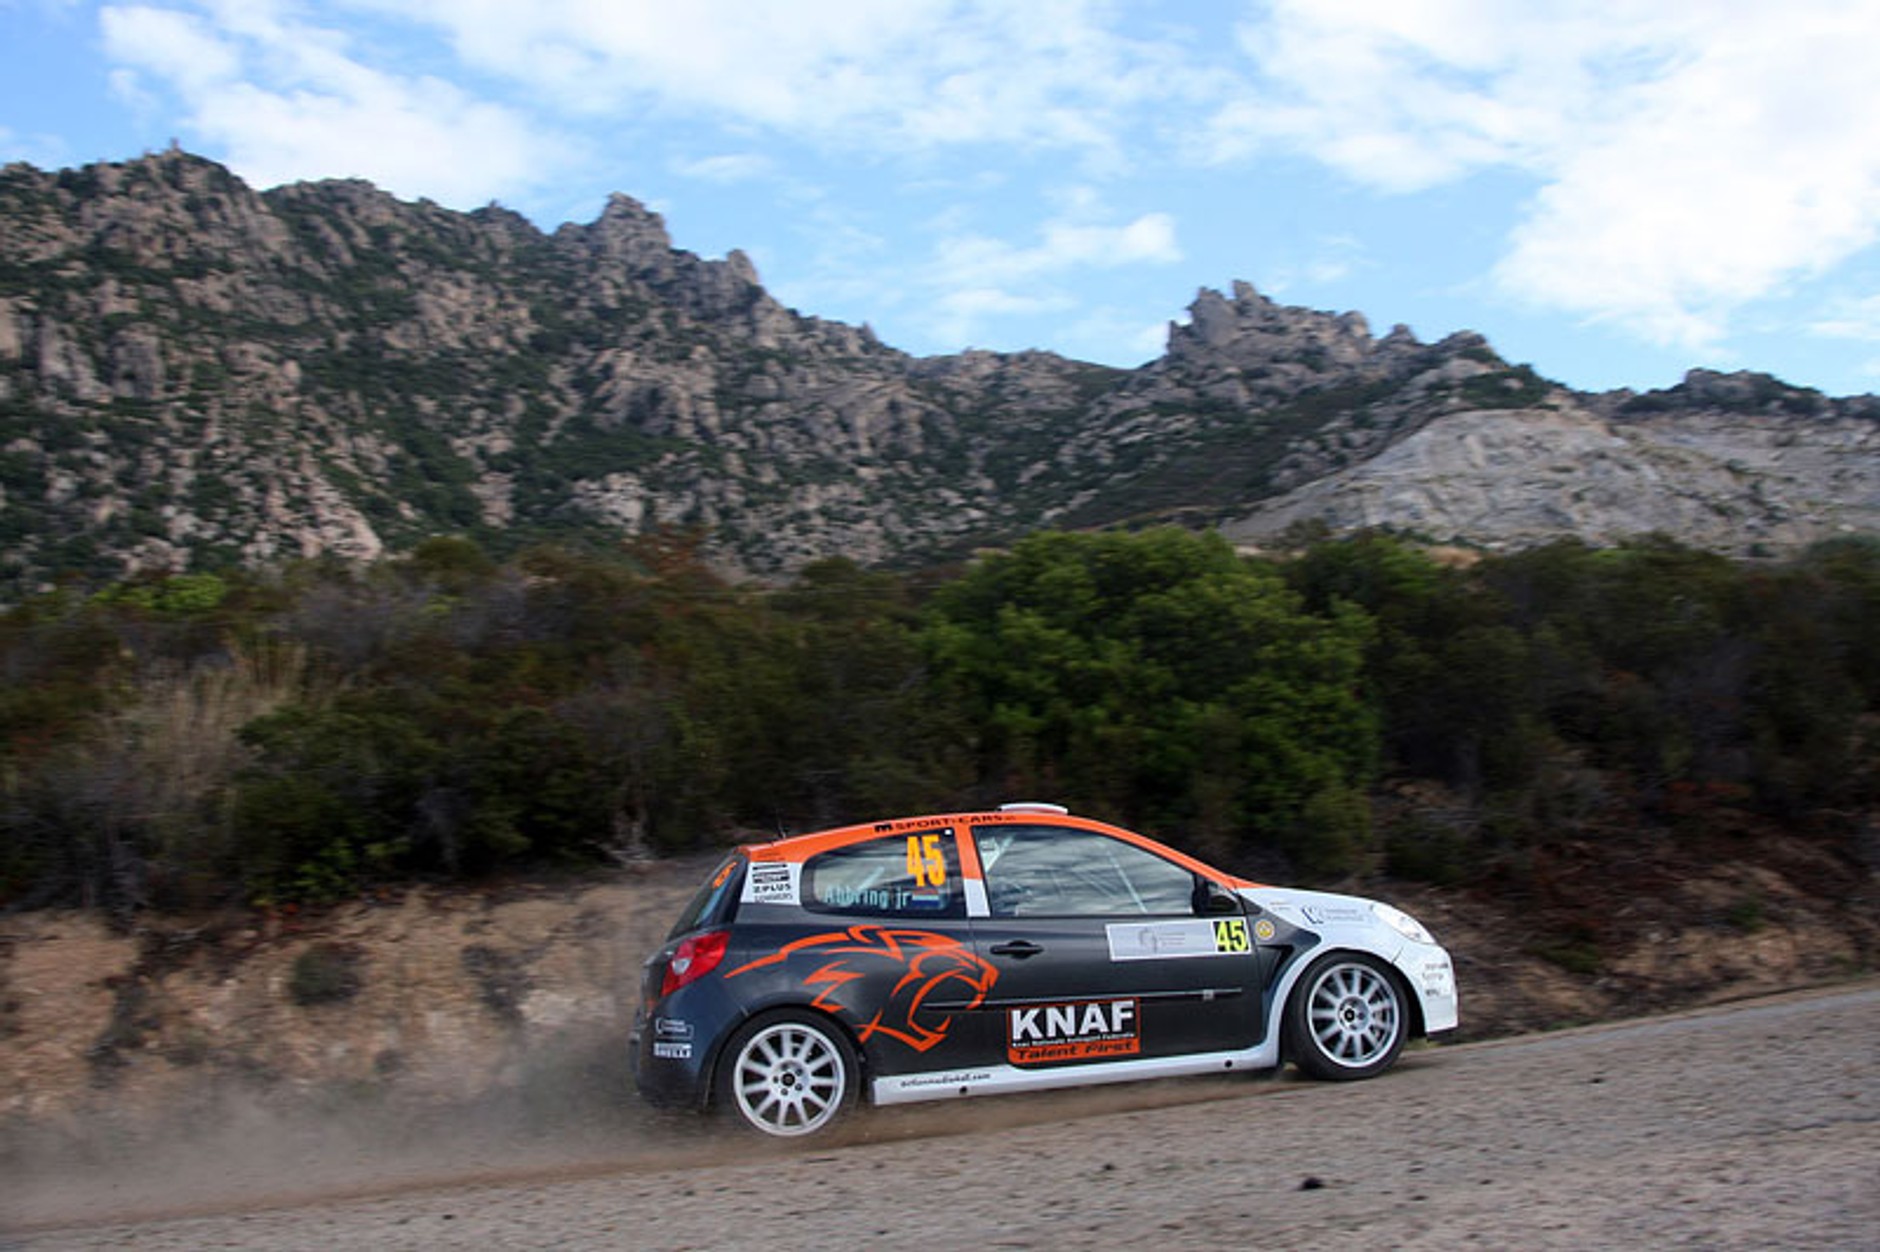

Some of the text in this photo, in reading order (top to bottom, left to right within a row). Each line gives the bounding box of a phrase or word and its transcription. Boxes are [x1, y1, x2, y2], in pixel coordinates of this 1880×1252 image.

[906, 834, 946, 887] 45
[1215, 920, 1249, 952] 45
[1011, 1000, 1135, 1040] KNAF
[1016, 1042, 1132, 1060] Talent First
